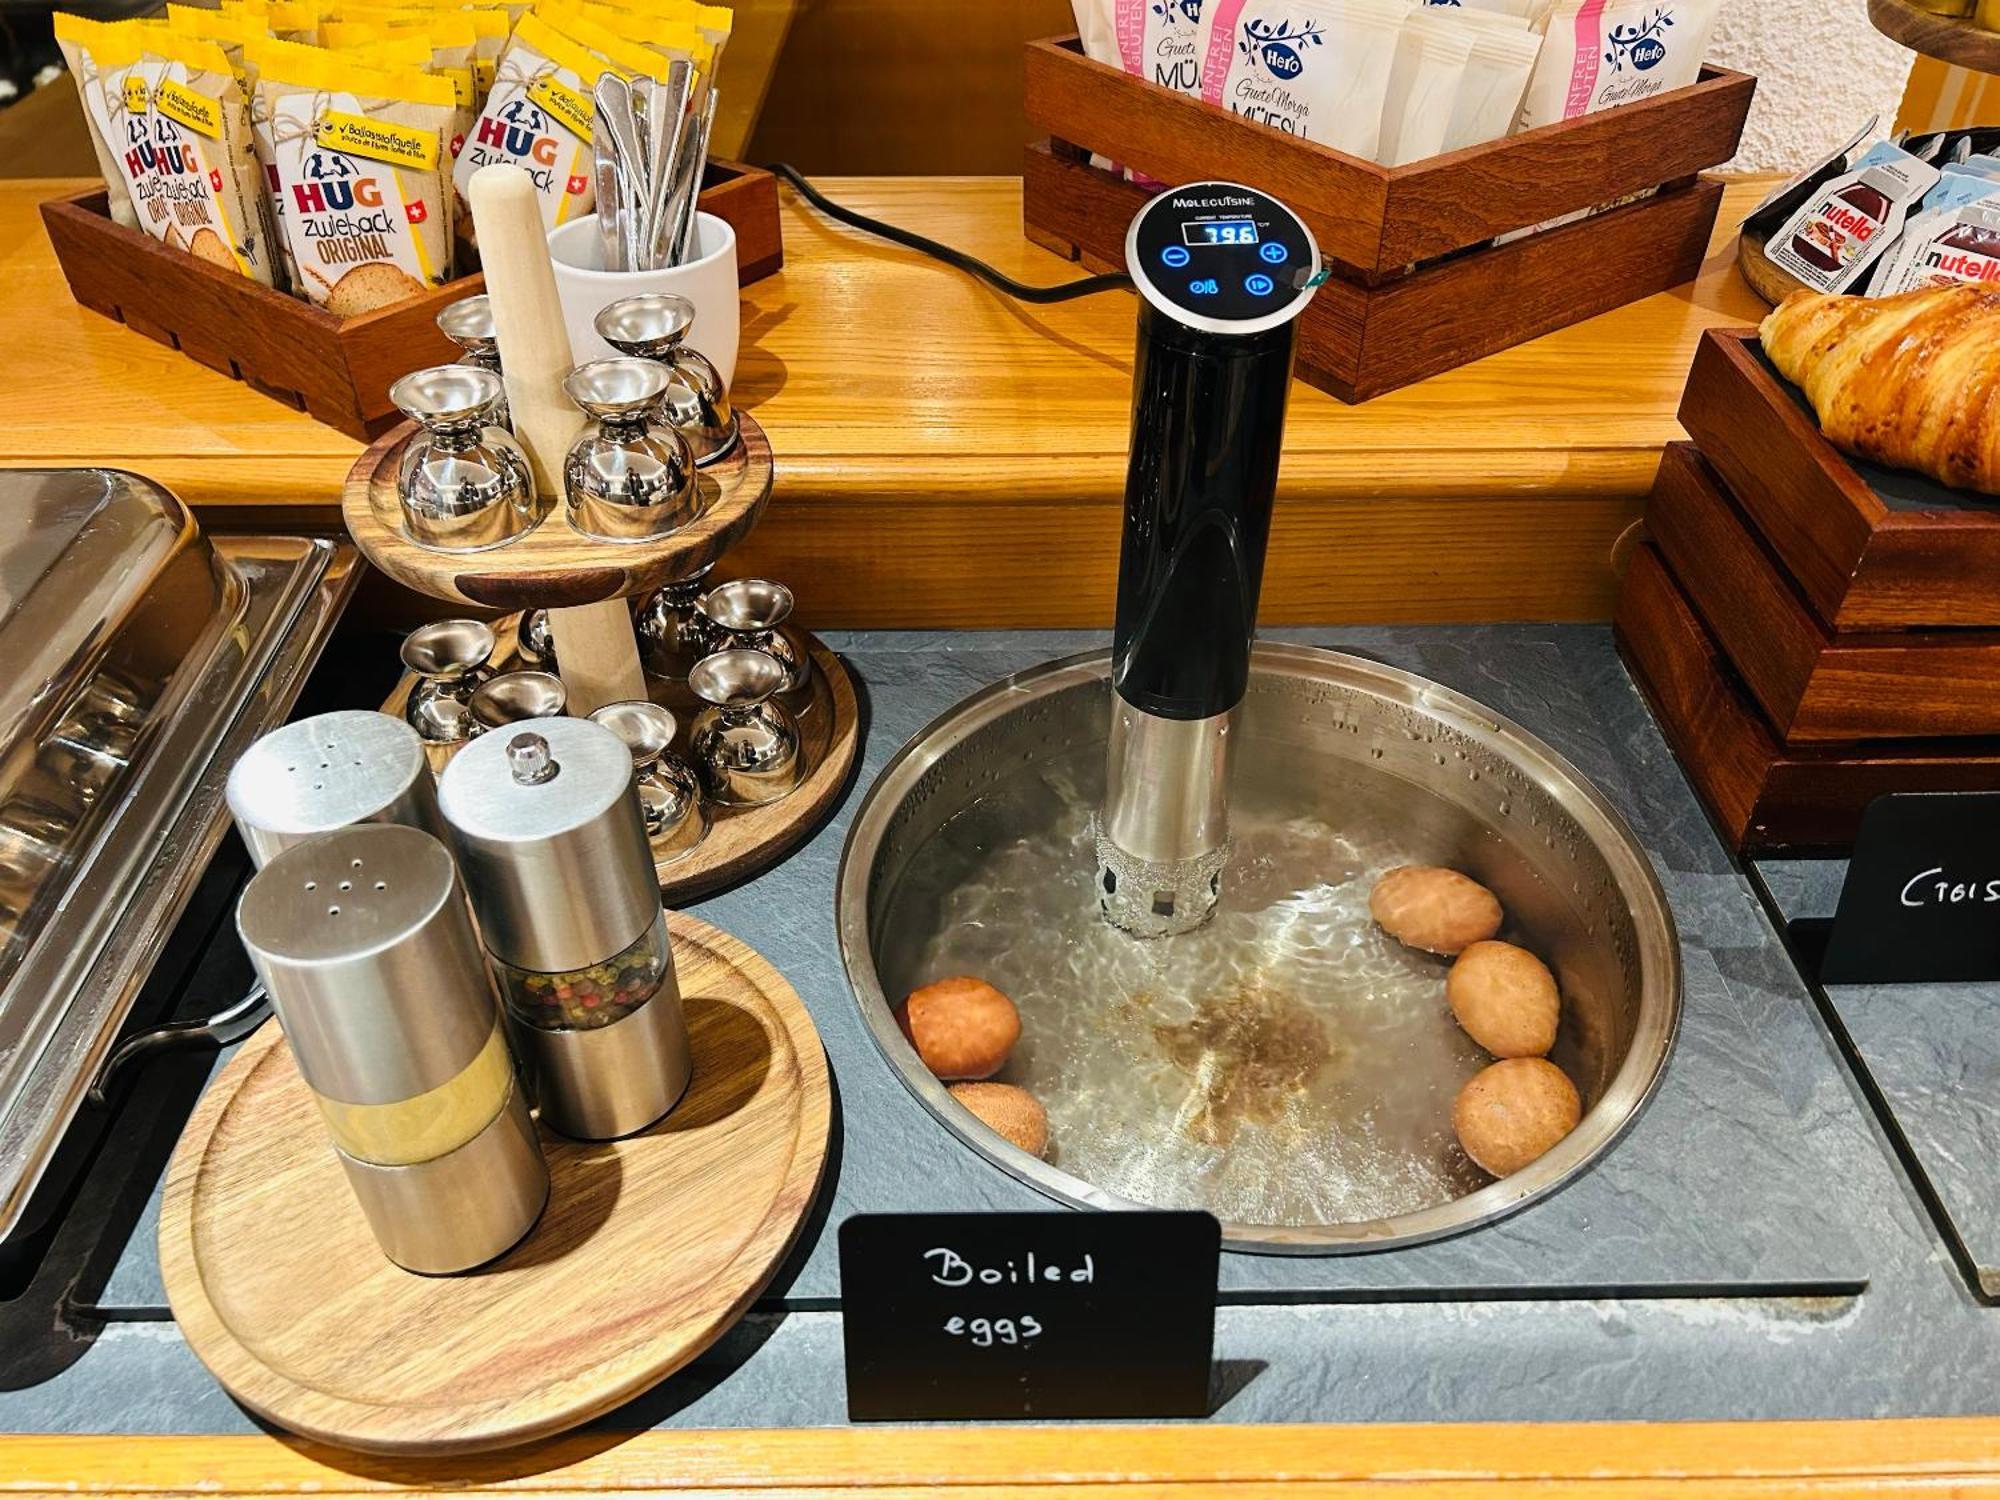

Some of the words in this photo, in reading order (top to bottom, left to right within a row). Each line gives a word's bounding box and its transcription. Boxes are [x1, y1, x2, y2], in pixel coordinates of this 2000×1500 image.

[1266, 50, 1299, 73] Hero
[1634, 44, 1664, 63] Hero
[477, 117, 559, 167] HUG
[125, 139, 156, 179] HU
[153, 144, 198, 175] HUG
[292, 178, 384, 214] HUG
[1818, 201, 1872, 242] nutella
[317, 235, 394, 265] ORIGINAL
[1925, 251, 2000, 282] nutell
[1901, 867, 2000, 907] Crois
[924, 1248, 1094, 1286] Boiled
[944, 1315, 1043, 1346] eggs
